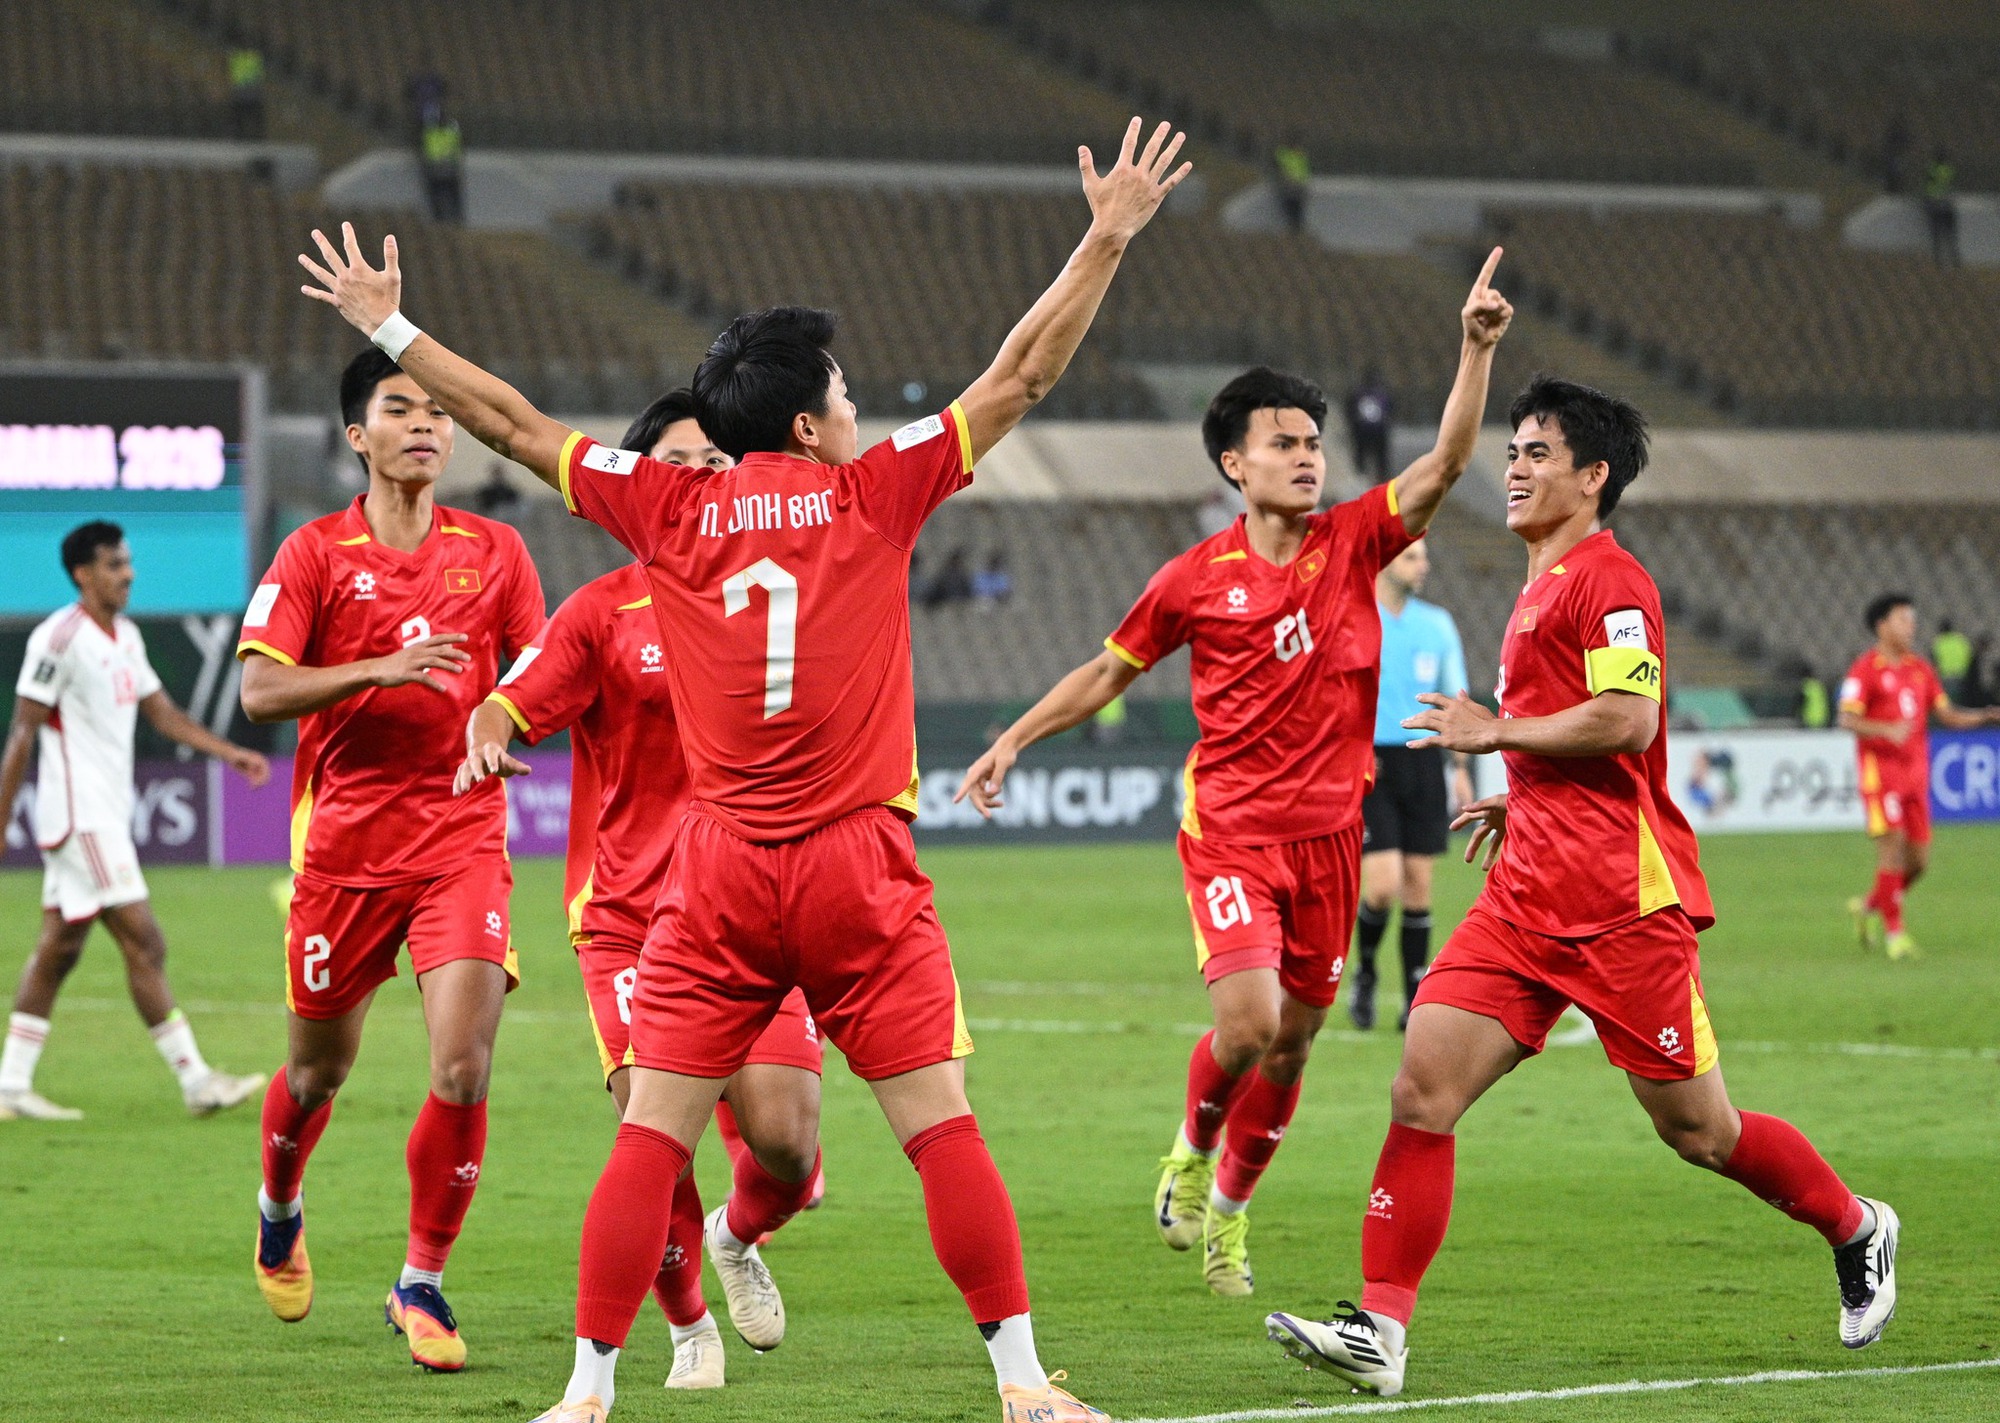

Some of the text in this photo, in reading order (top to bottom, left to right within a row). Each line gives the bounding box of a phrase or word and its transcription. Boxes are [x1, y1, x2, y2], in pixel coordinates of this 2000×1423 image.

[700, 488, 833, 538] N. DINH BAC
[722, 557, 798, 720] 7
[1273, 607, 1314, 663] 21
[1613, 625, 1640, 642] AFC
[1052, 764, 1162, 828] CUP
[1931, 743, 2000, 811] CR
[1205, 875, 1252, 931] 21
[304, 933, 331, 993] 2
